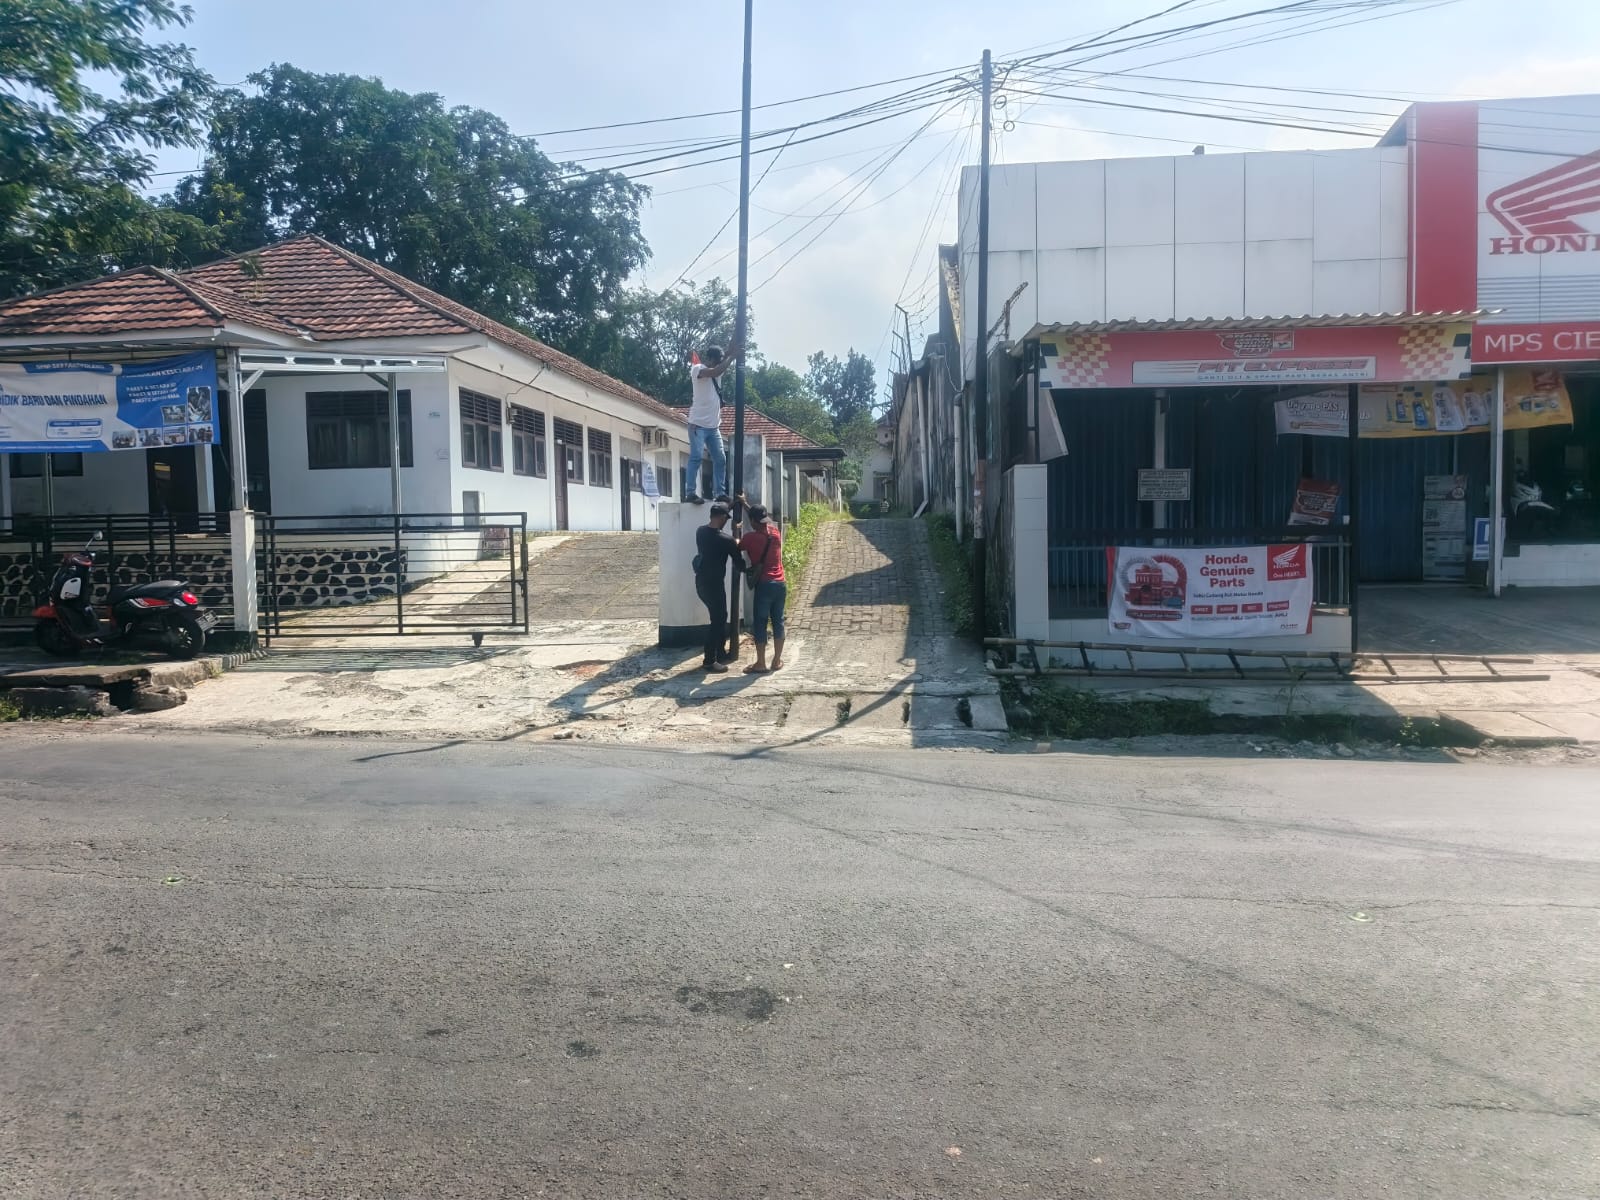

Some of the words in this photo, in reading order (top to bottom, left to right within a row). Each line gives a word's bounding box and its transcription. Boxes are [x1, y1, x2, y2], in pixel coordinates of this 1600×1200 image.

[1489, 234, 1600, 255] HON
[1484, 333, 1543, 353] MPS
[1244, 358, 1369, 371] EXPRESS
[0, 394, 19, 406] IDIK
[21, 394, 45, 406] BARU
[45, 394, 63, 406] DAN
[63, 394, 108, 406] PINDAHAN
[1204, 553, 1248, 564] Honda
[1199, 565, 1255, 576] Genuine
[1209, 577, 1246, 588] Parts
